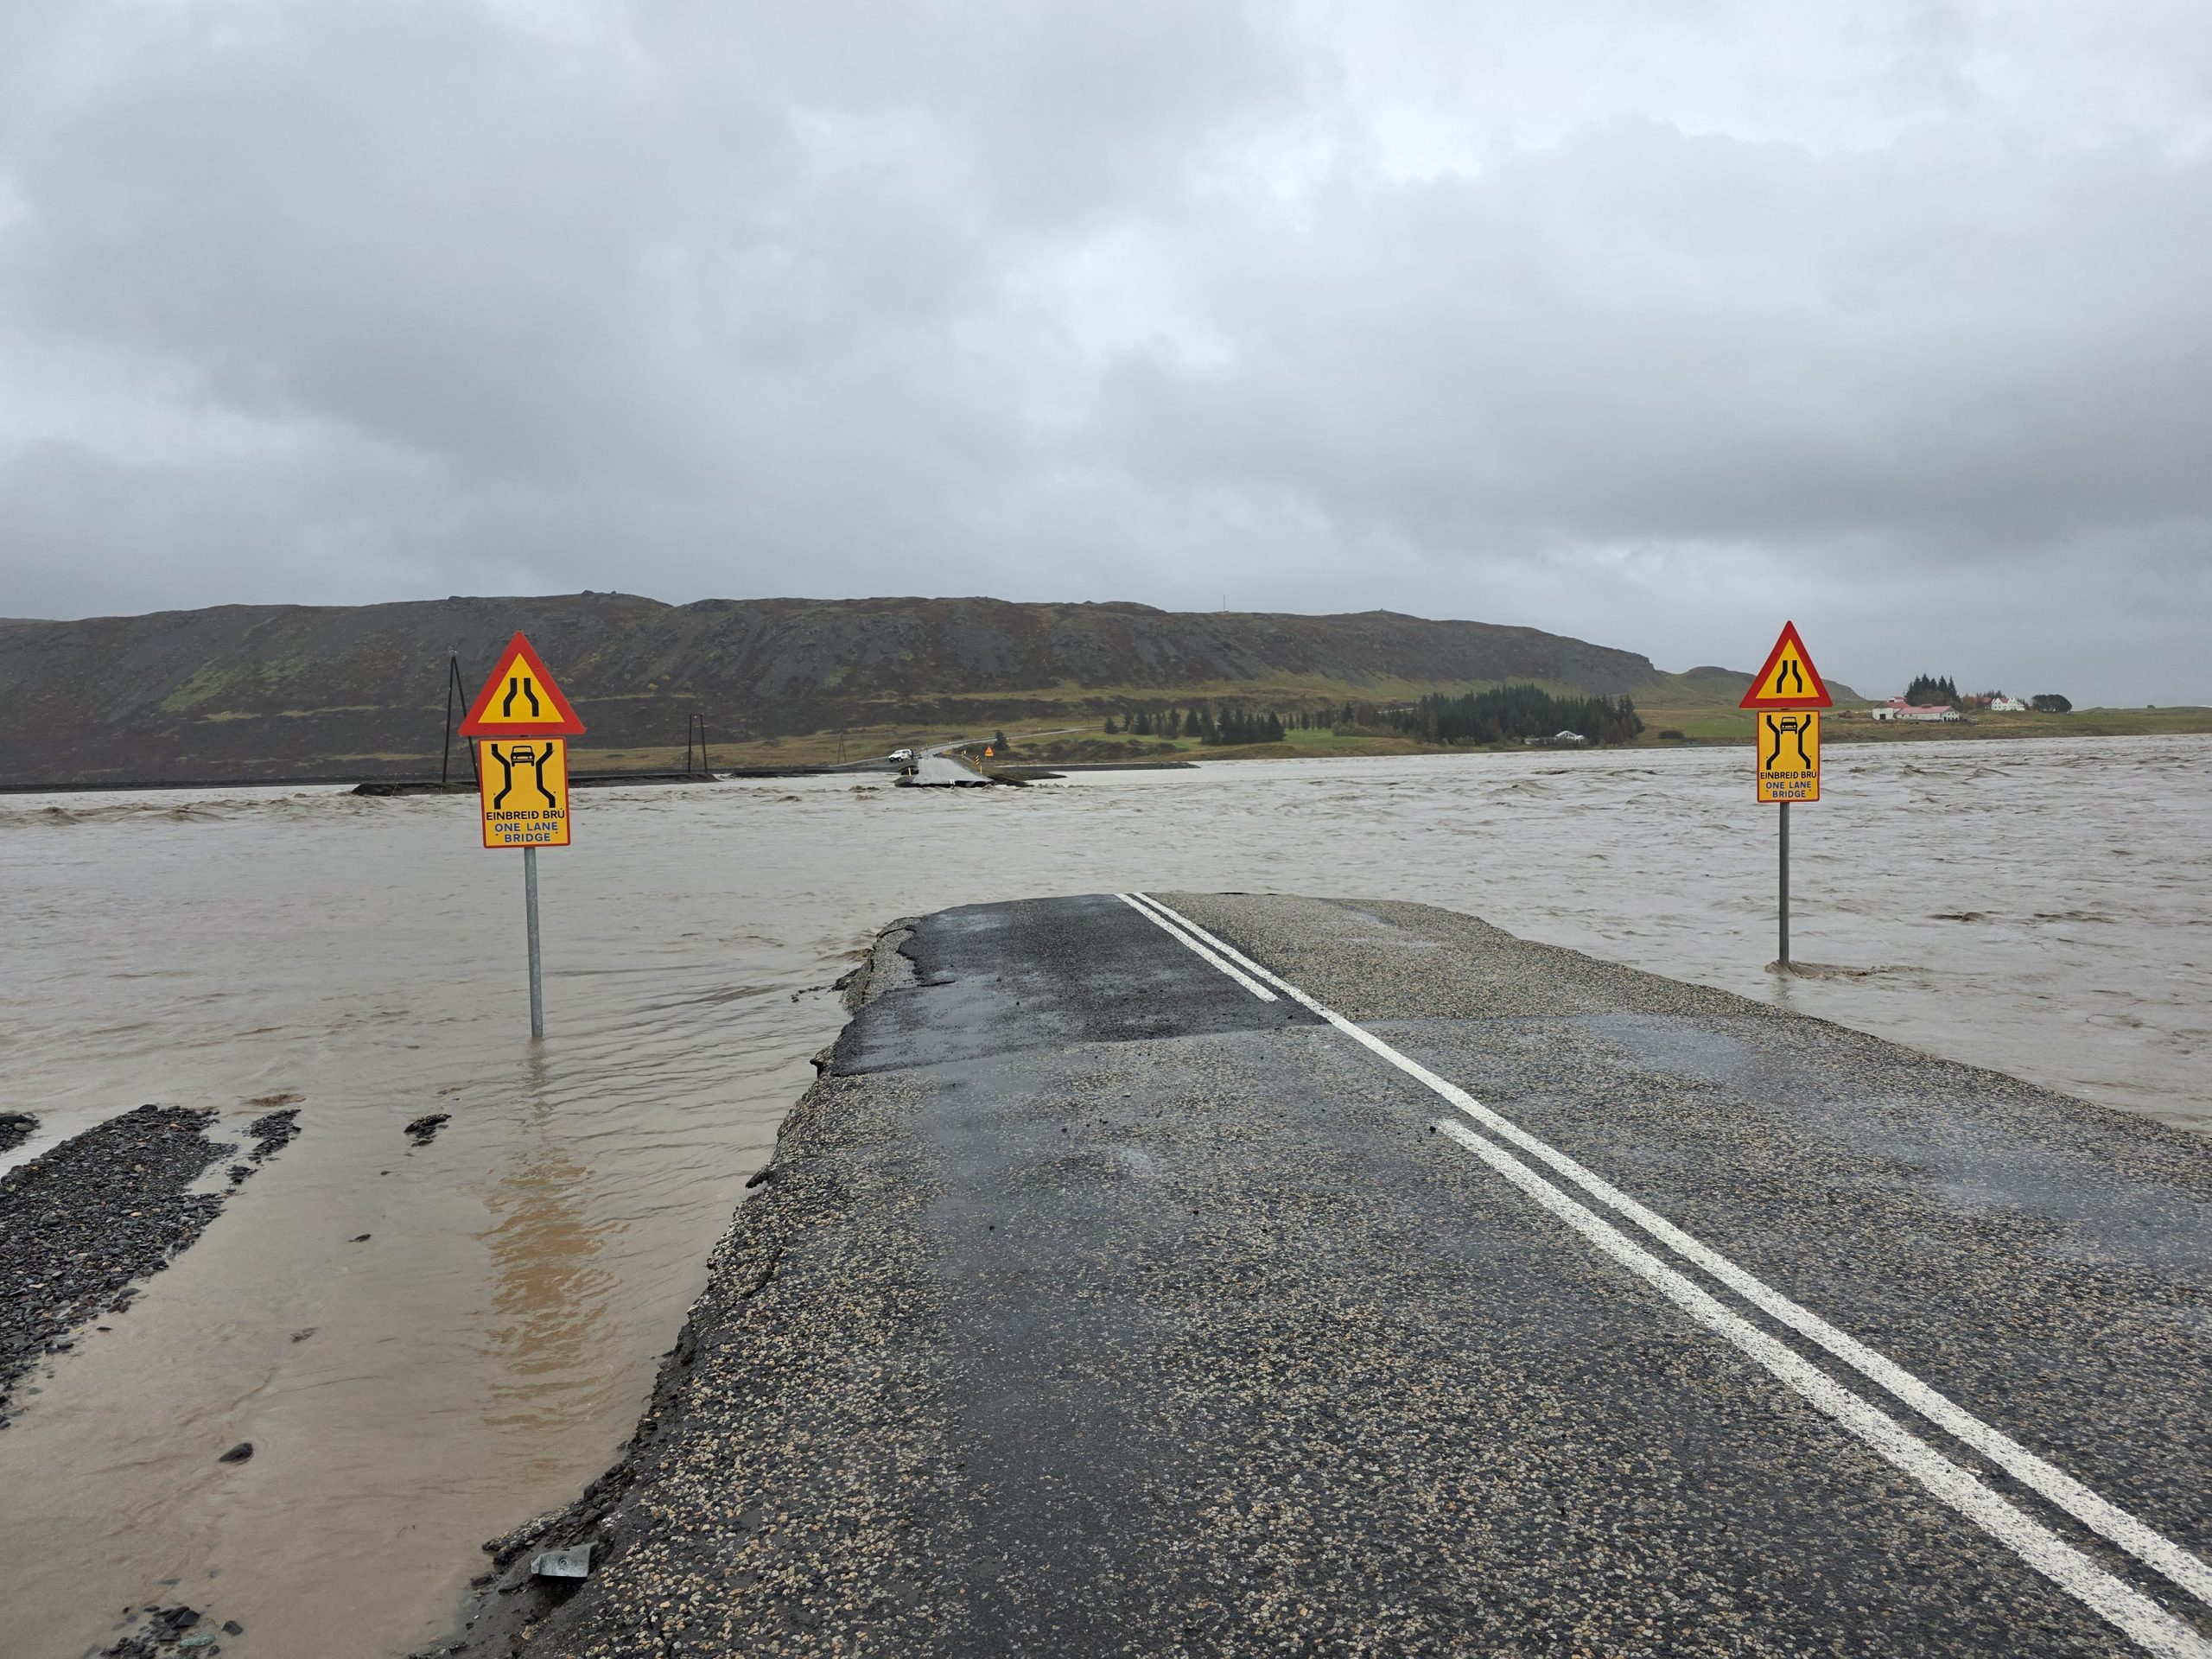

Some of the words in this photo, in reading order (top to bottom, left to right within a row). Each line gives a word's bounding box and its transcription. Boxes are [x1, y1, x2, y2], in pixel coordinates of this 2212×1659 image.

[1760, 771, 1799, 779] EINBREIÐ
[1801, 769, 1817, 779] BRÚ
[486, 810, 539, 821] EINBREIÐ
[543, 808, 565, 819] BRÚ
[495, 823, 520, 832] ONE
[526, 822, 558, 831] LANE
[505, 833, 550, 842] BRIDGE
